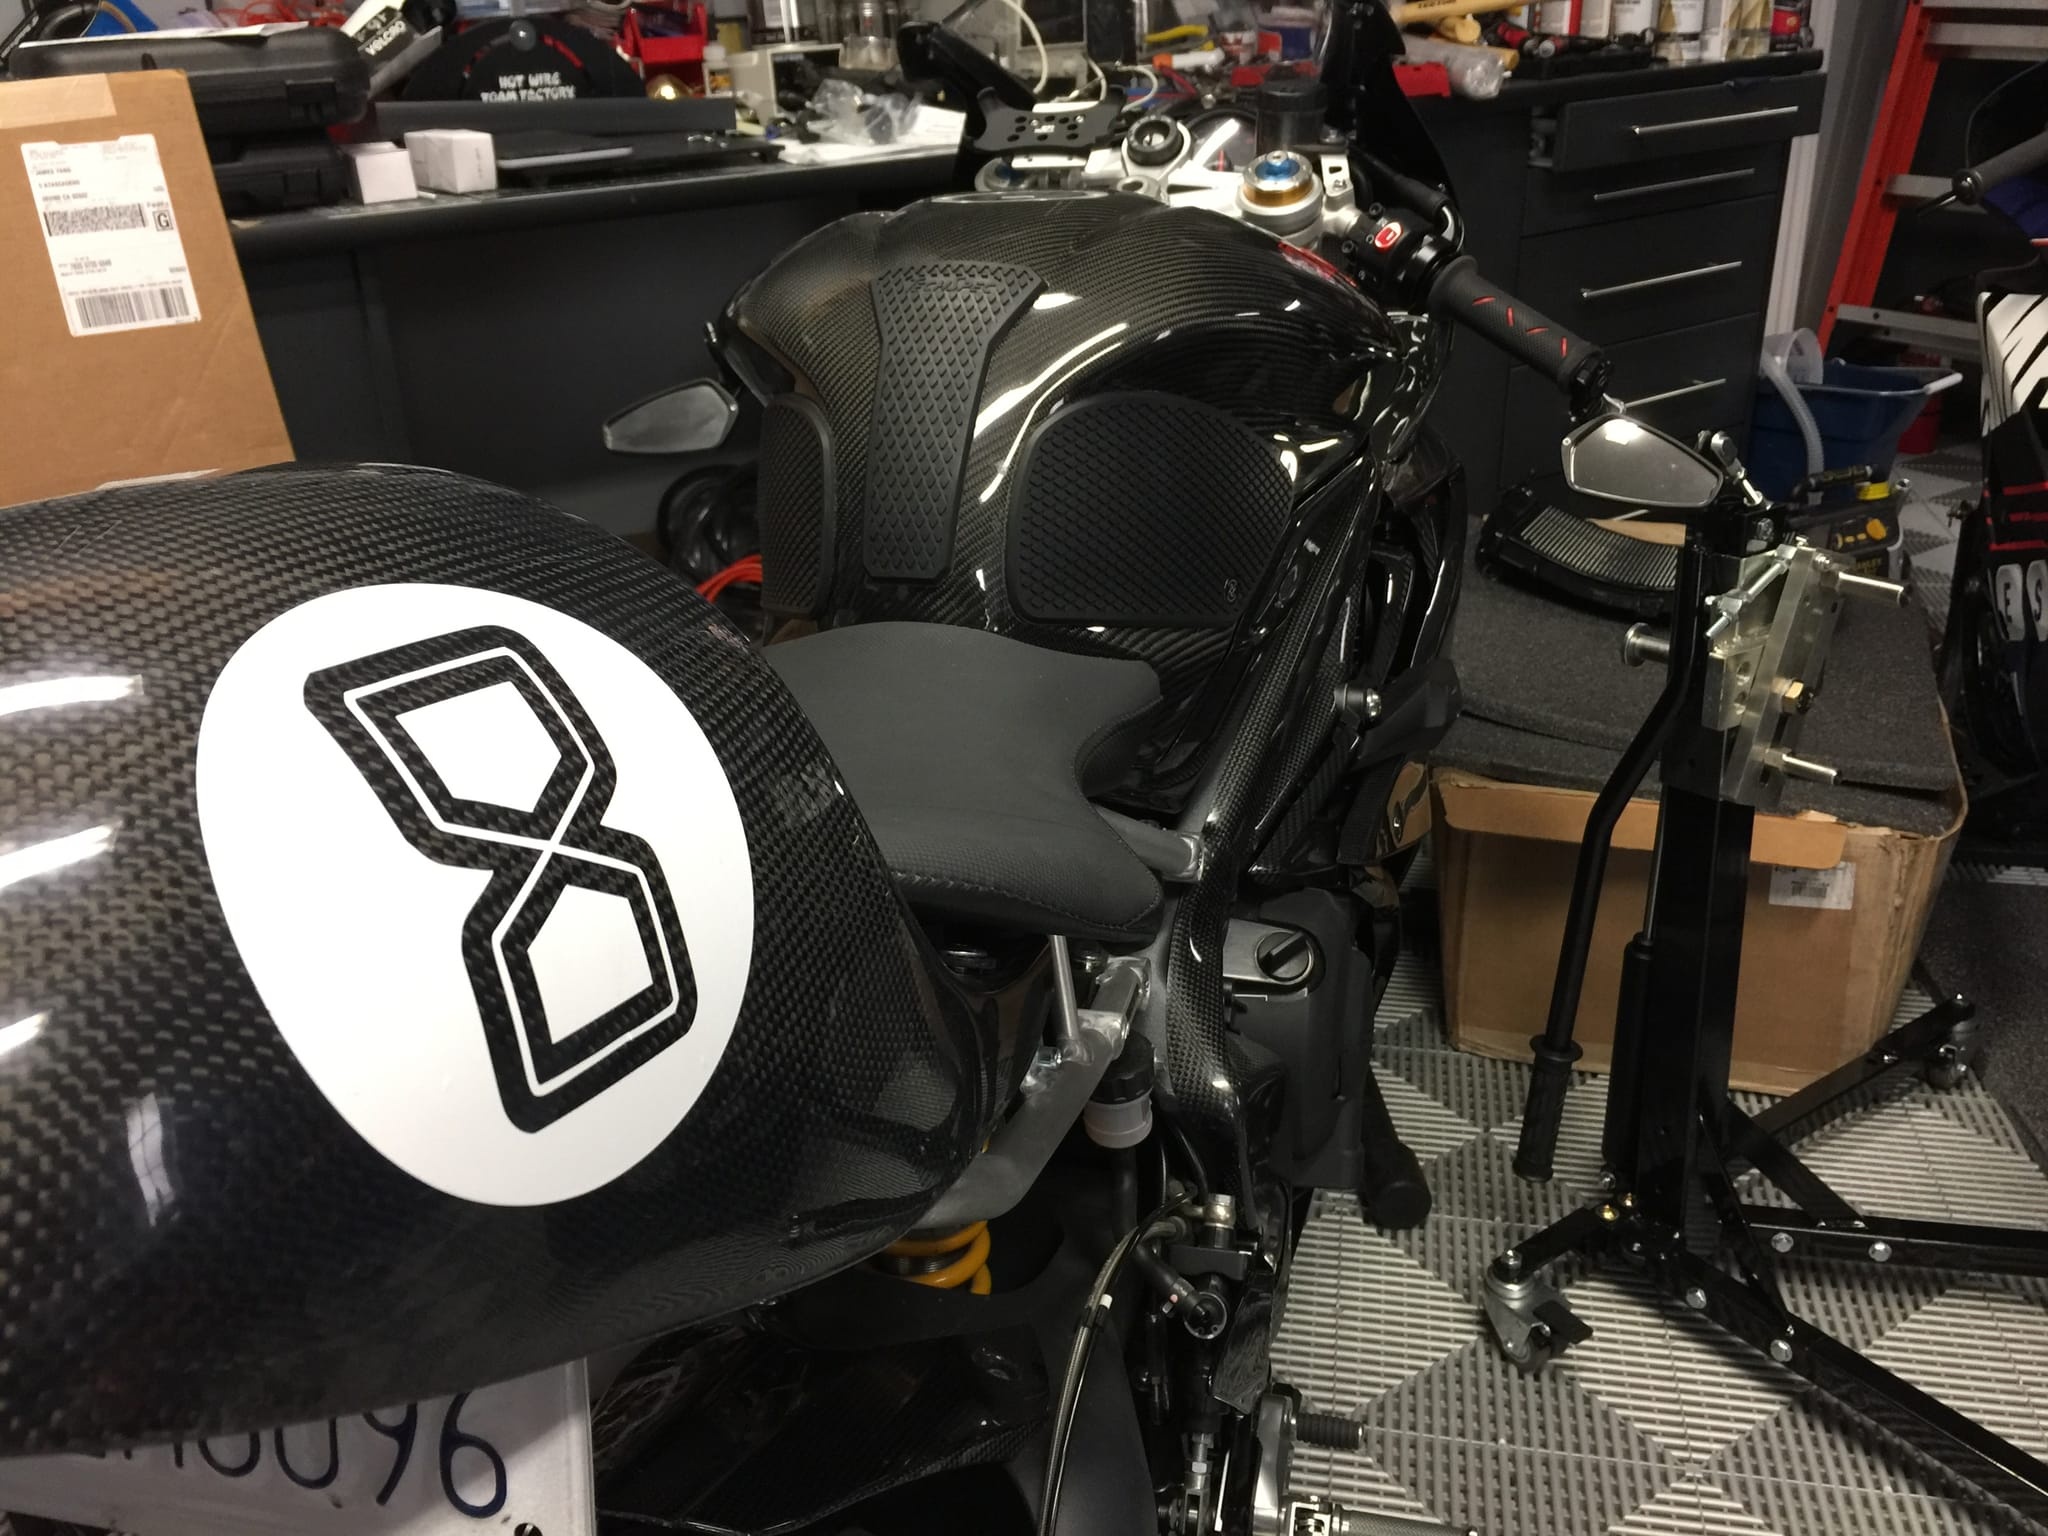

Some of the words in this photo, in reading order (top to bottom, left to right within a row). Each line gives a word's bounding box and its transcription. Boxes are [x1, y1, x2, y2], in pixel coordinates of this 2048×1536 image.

[499, 74, 524, 89] HOT
[528, 71, 560, 87] WIRE
[480, 91, 518, 103] FOAM
[519, 85, 576, 102] FACTORY
[157, 213, 170, 229] G
